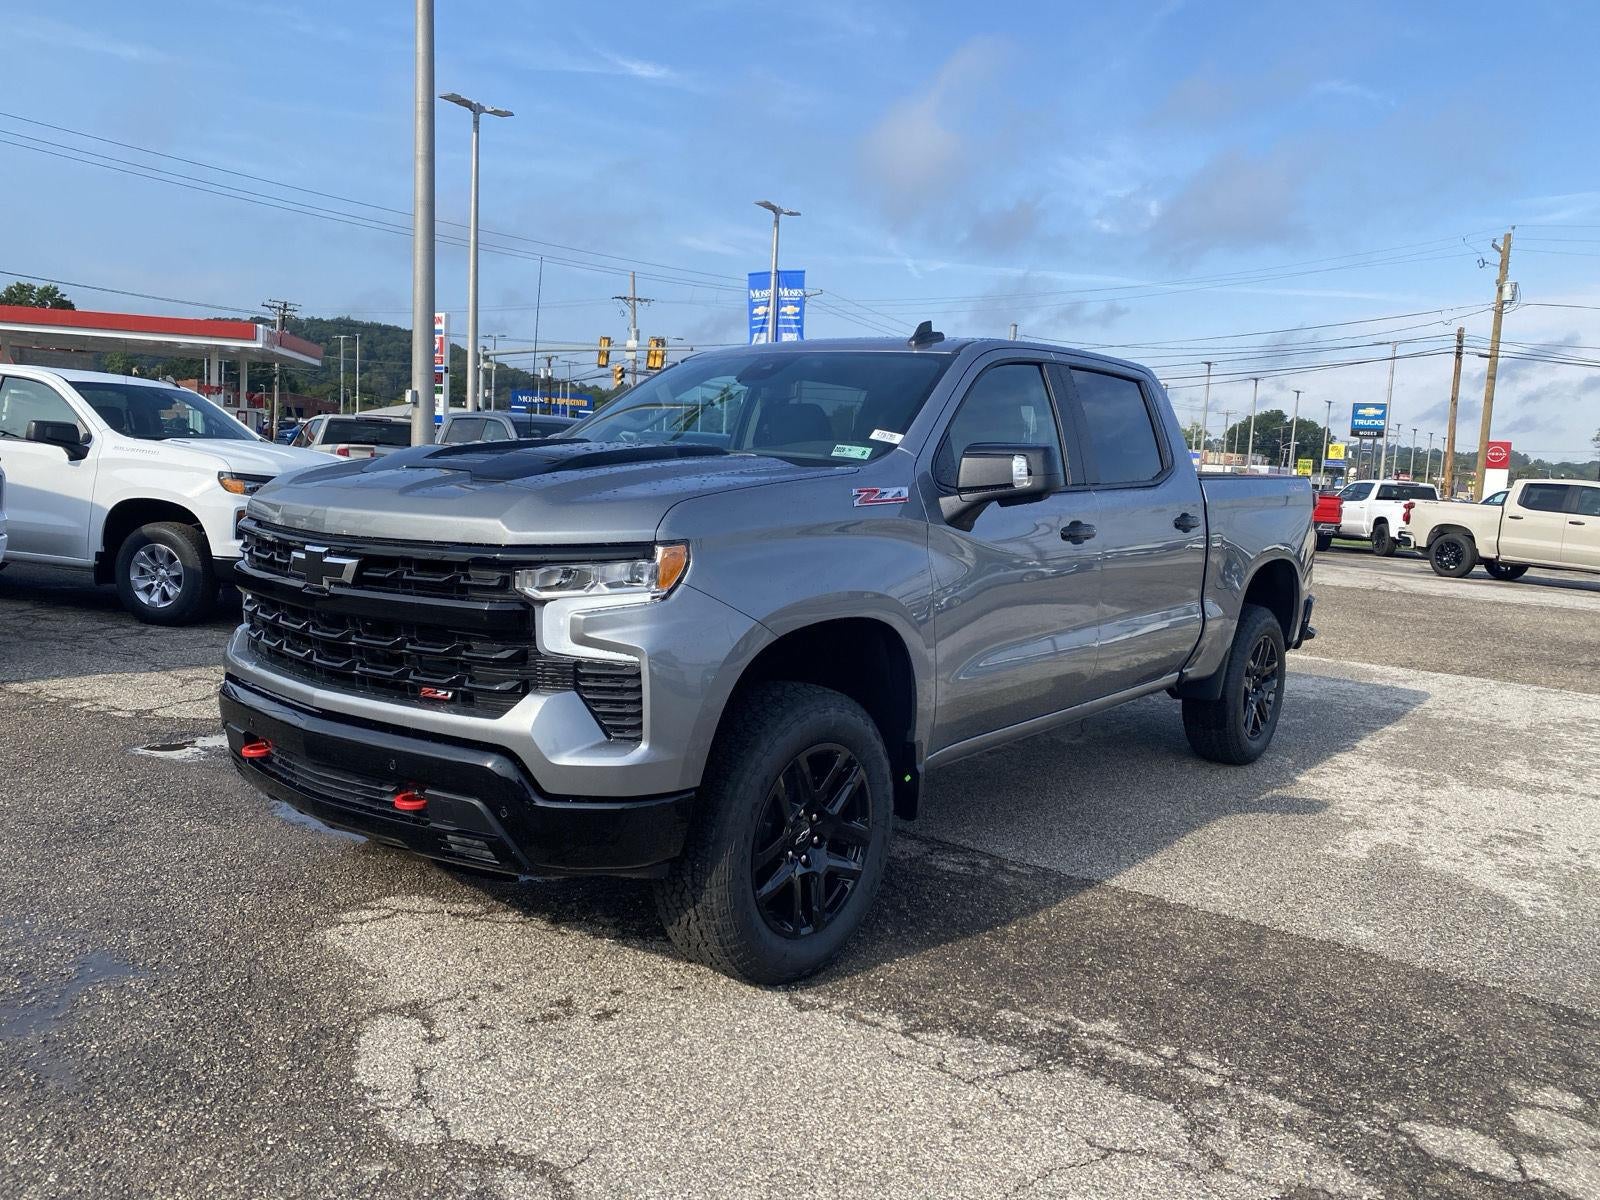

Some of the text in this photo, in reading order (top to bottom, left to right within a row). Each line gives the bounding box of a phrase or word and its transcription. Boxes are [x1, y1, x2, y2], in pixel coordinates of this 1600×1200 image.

[749, 288, 772, 299] MOSE
[853, 487, 909, 507] Z71
[420, 687, 453, 700] Z71
